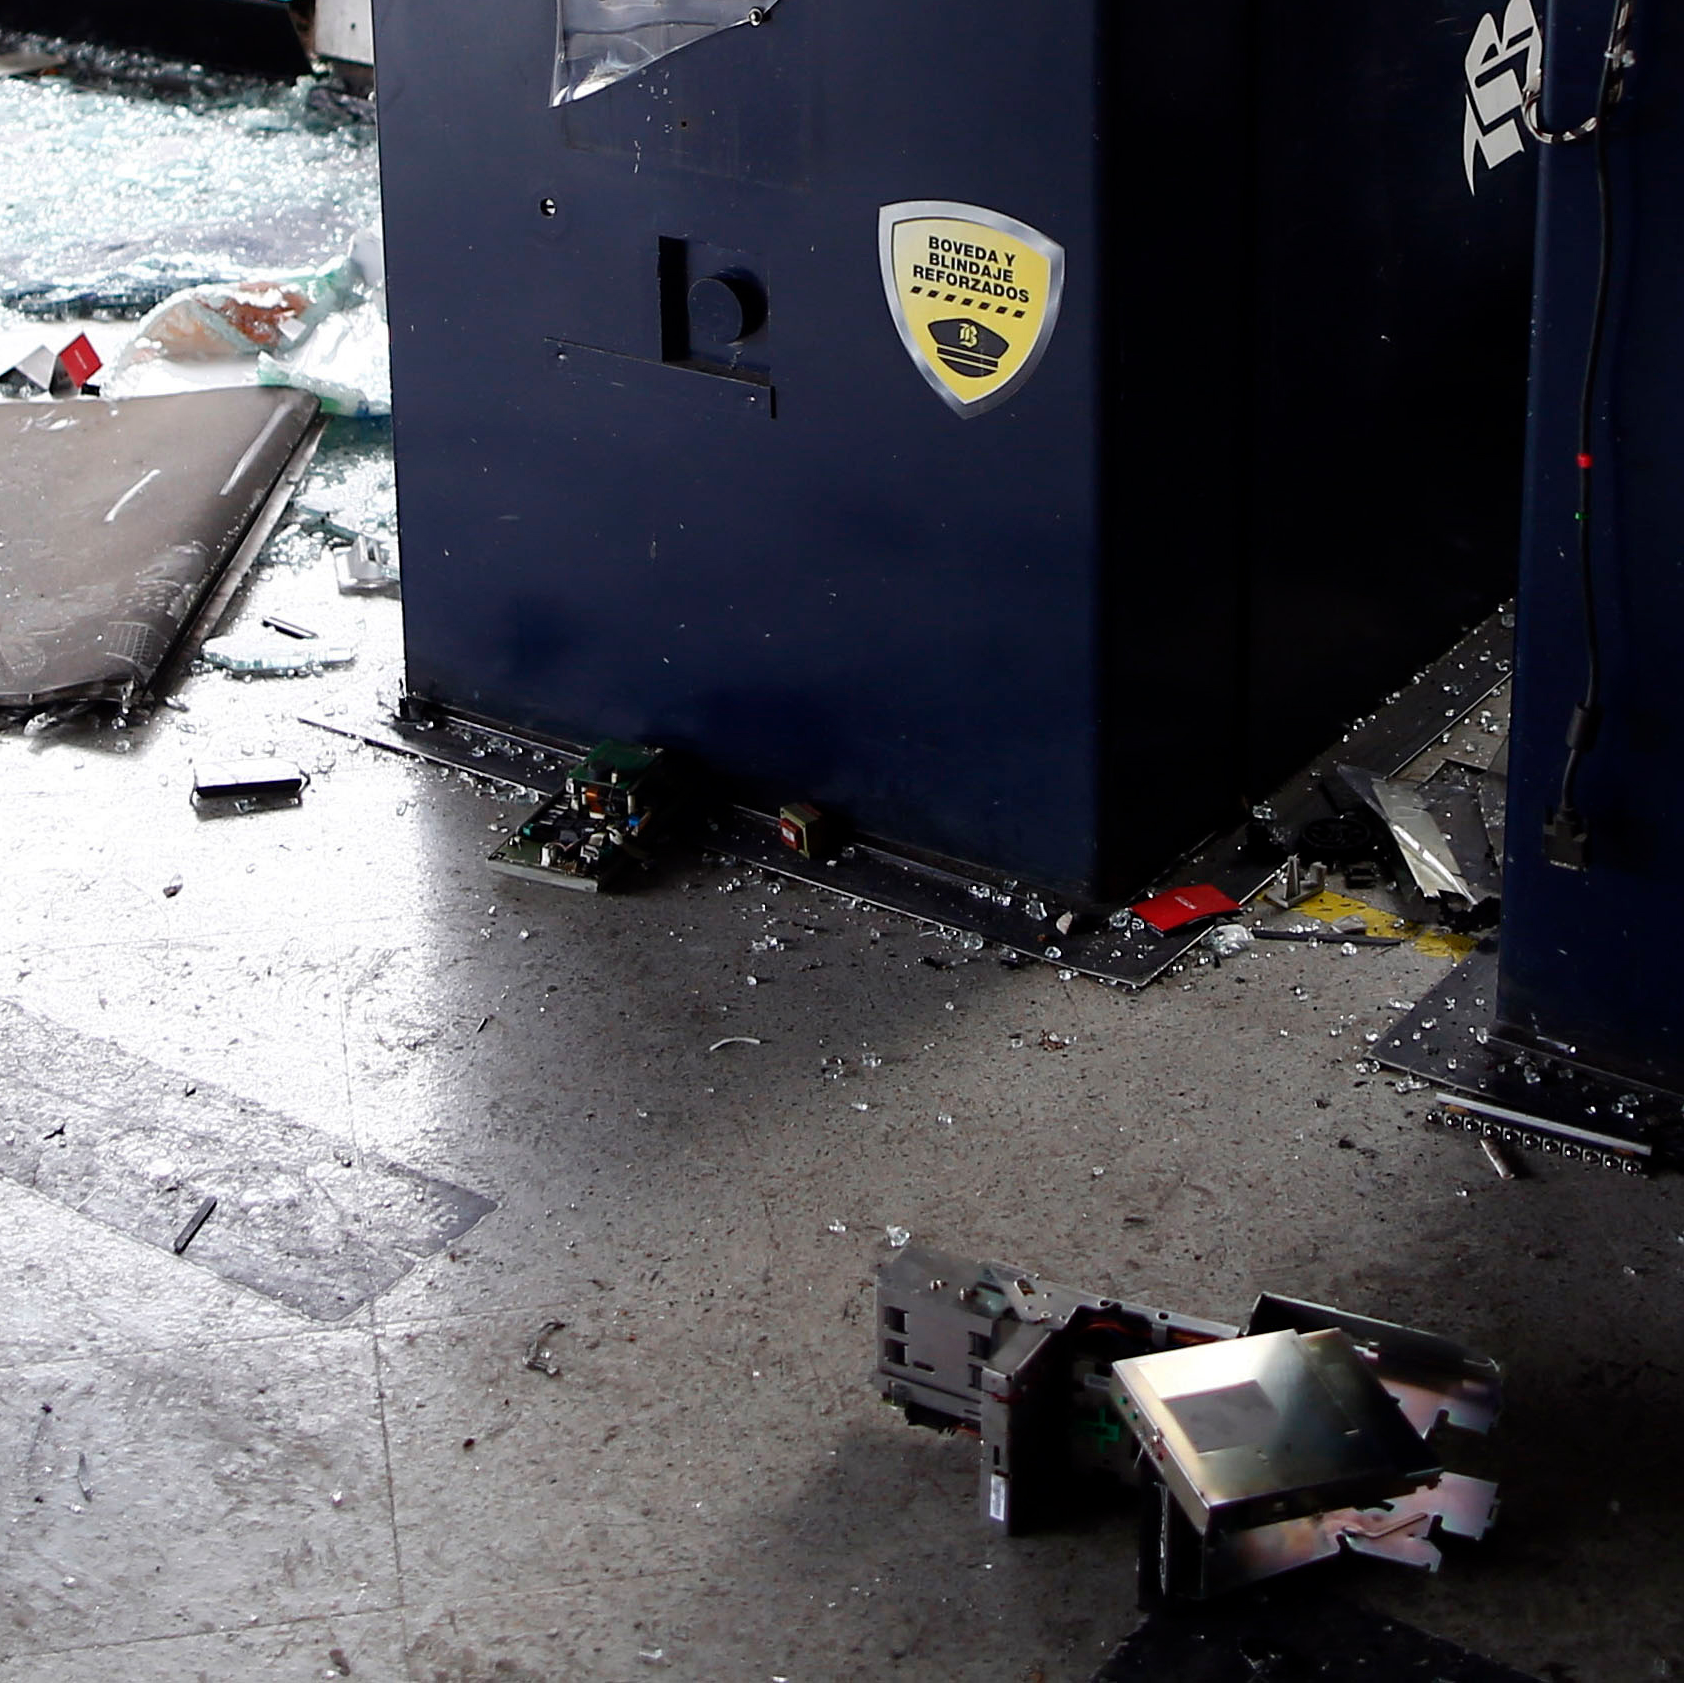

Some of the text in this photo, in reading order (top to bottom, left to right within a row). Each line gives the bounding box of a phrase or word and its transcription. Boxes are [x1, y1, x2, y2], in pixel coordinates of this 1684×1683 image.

[928, 235, 1016, 267] BOVEDA Y
[912, 264, 1030, 304] REFORZADOS
[928, 252, 1014, 284] BLINDAJE
